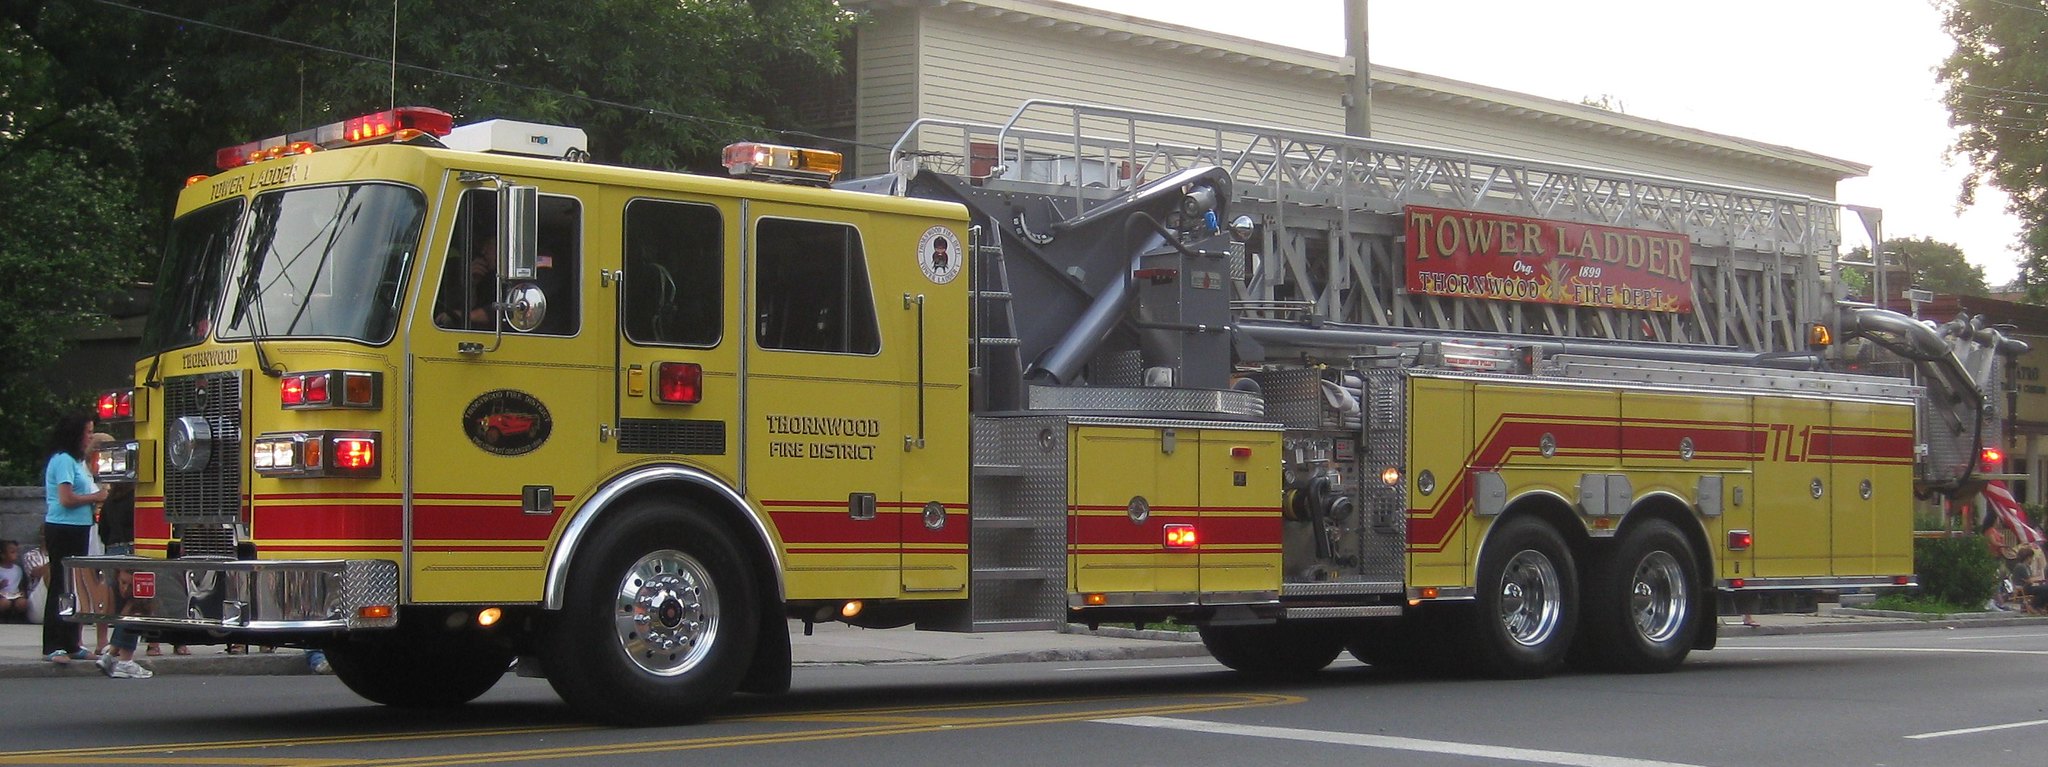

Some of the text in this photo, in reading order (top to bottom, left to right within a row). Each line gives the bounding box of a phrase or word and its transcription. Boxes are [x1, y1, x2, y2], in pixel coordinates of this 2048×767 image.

[211, 175, 244, 200] TOWER
[248, 164, 297, 190] LADDER
[1411, 212, 1688, 284] TOWER LADDER
[1513, 259, 1601, 278] Org. 1899
[1419, 271, 1539, 299] THORNWOOD
[1573, 283, 1614, 305] FIRE
[766, 415, 880, 437] THORNWOOD
[1770, 423, 1811, 463] TL1
[769, 441, 876, 461] FIRE DISTRICT
